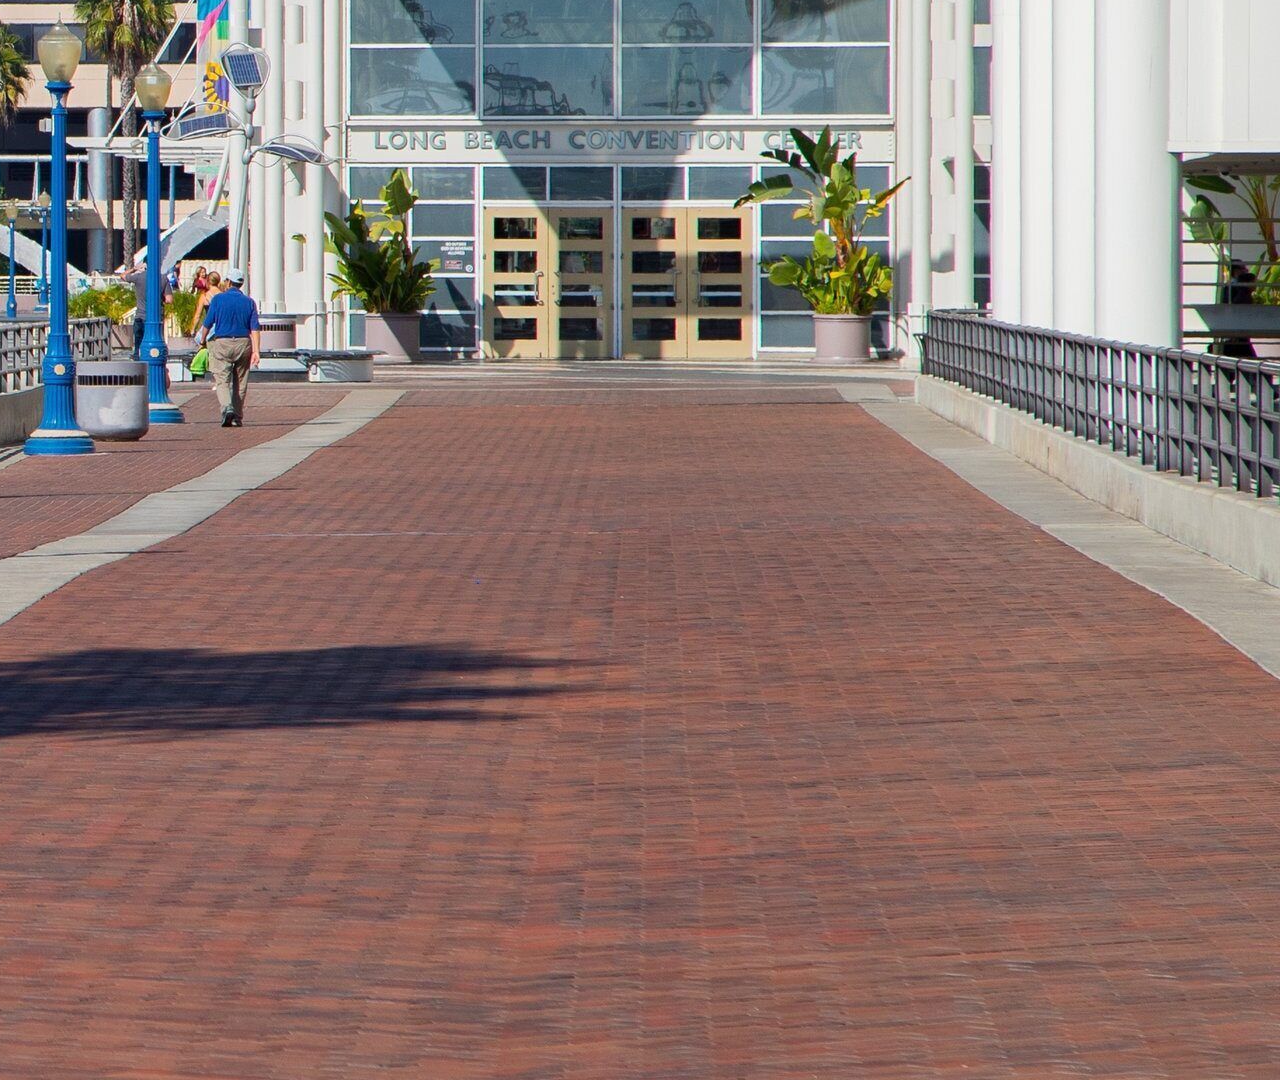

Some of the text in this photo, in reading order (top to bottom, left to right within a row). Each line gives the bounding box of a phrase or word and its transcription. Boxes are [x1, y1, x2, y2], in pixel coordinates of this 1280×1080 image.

[374, 130, 863, 150] LONG BEACH CONVENTION CEER
